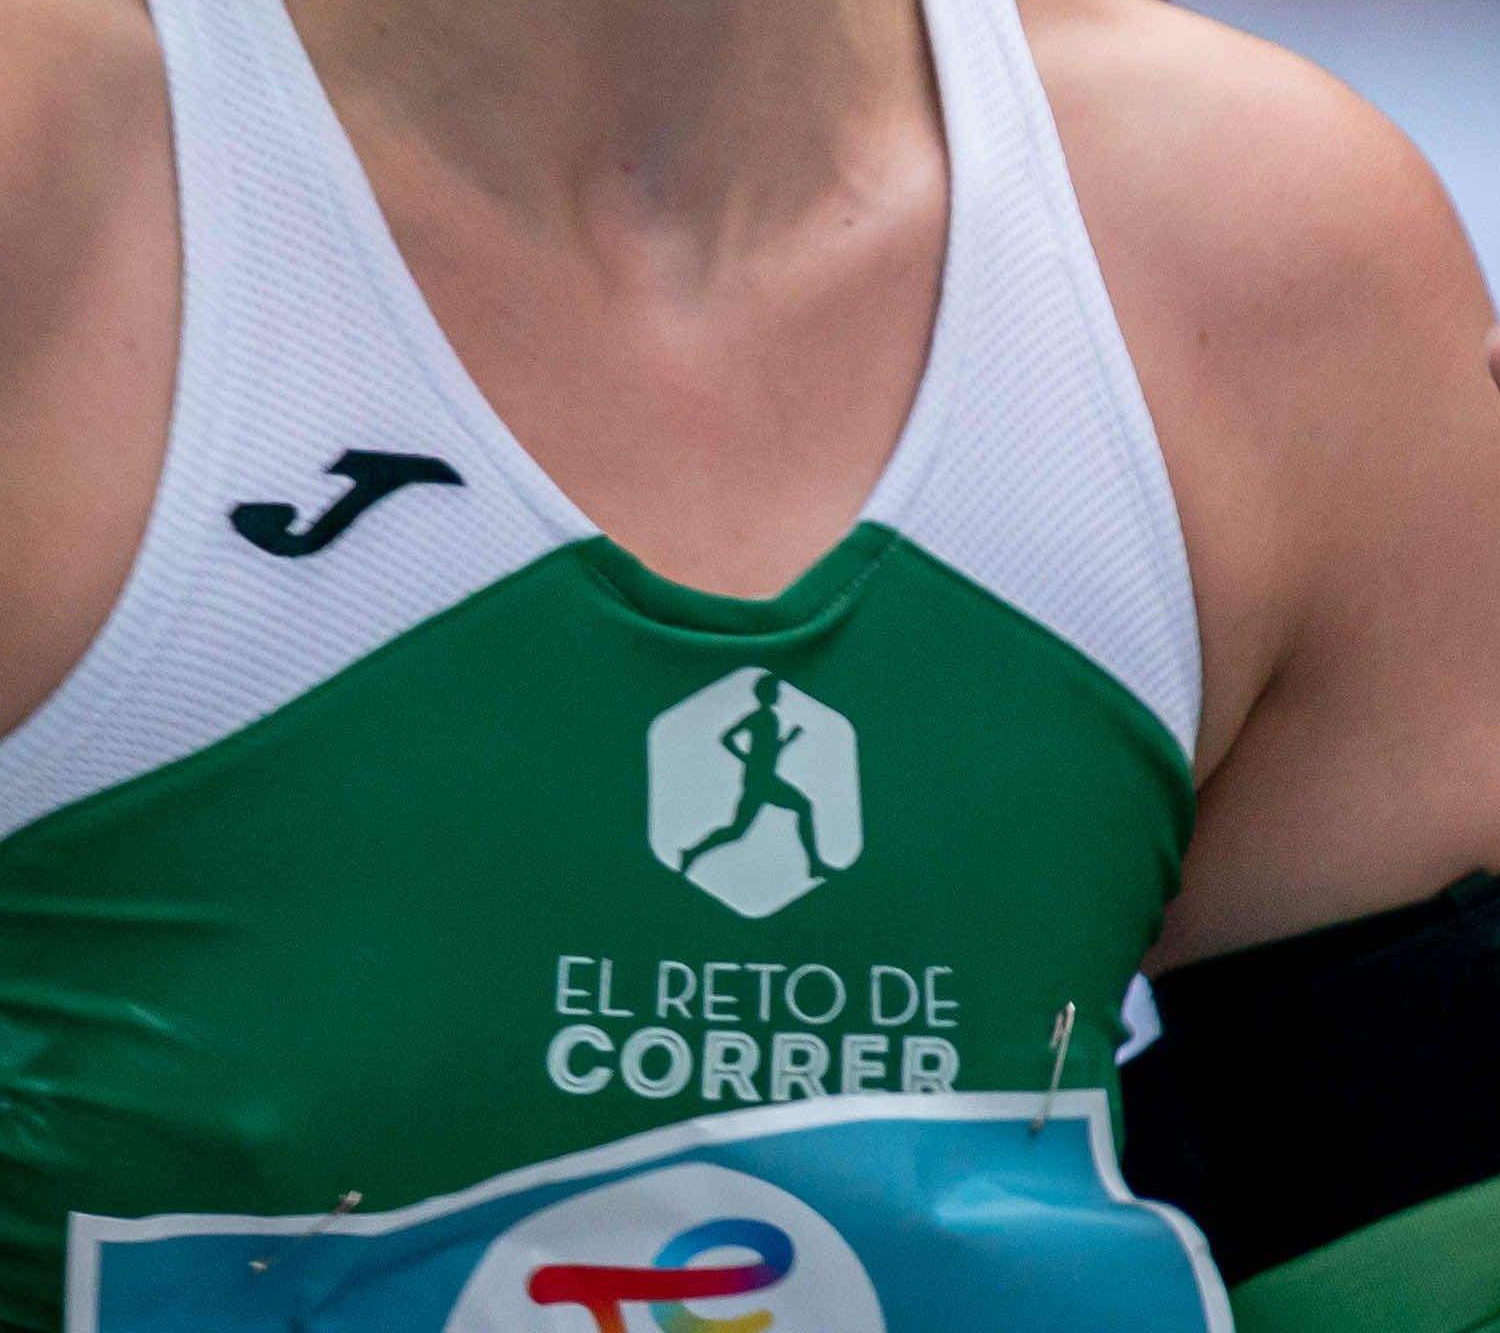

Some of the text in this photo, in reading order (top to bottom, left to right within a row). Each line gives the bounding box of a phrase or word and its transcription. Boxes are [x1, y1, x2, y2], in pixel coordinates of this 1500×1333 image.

[556, 955, 960, 1028] EL RETO DE
[546, 1023, 961, 1101] CORRER
